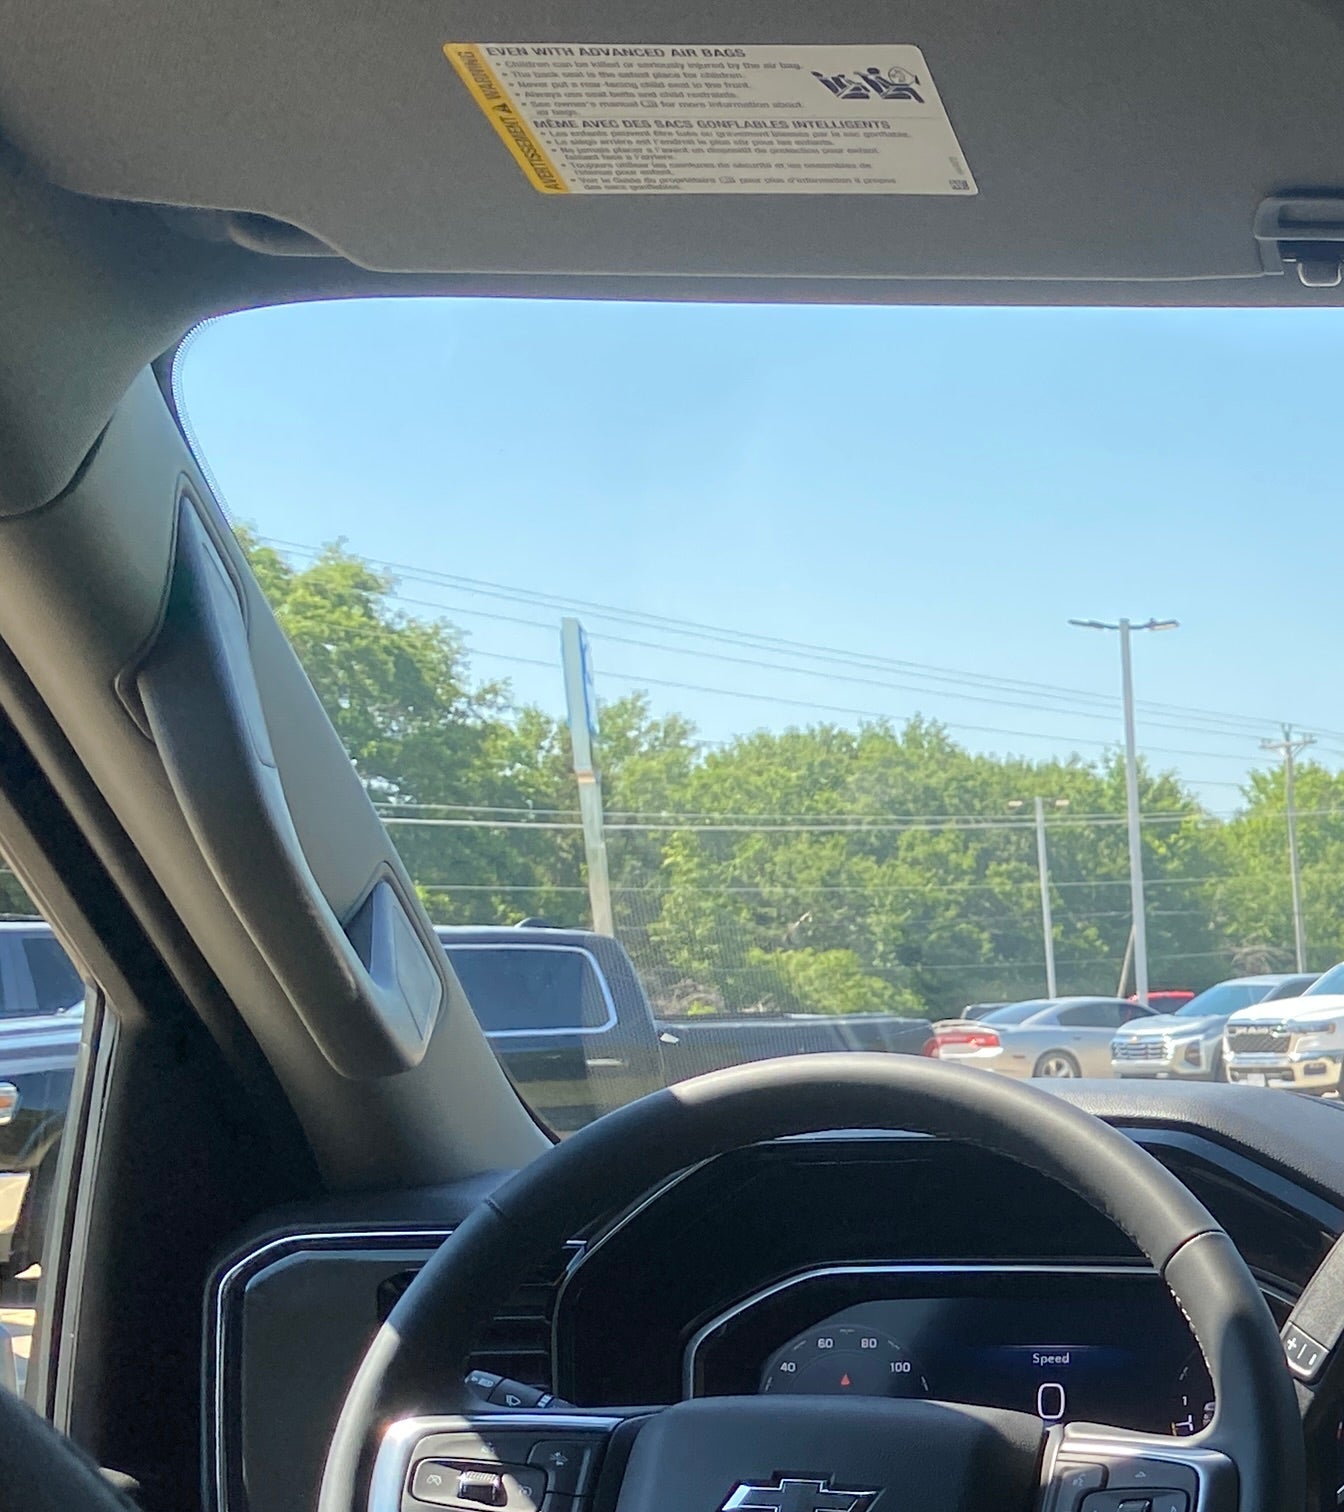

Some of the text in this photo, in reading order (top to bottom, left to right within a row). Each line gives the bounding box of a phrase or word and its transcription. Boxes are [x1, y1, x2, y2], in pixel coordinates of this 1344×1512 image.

[486, 47, 746, 57] EVEN WITH ADVANCED AIR BAGS
[457, 51, 502, 100] WARNING
[533, 119, 891, 129] MÊME AVEC DES SACS GONFLABLES INTELLIGENTS
[500, 115, 562, 190] AVERTISSEMENT
[817, 1338, 877, 1349] 60 80
[1032, 1352, 1070, 1366] Speed
[780, 1362, 911, 1372] 40 100
[1037, 1383, 1066, 1420] 0
